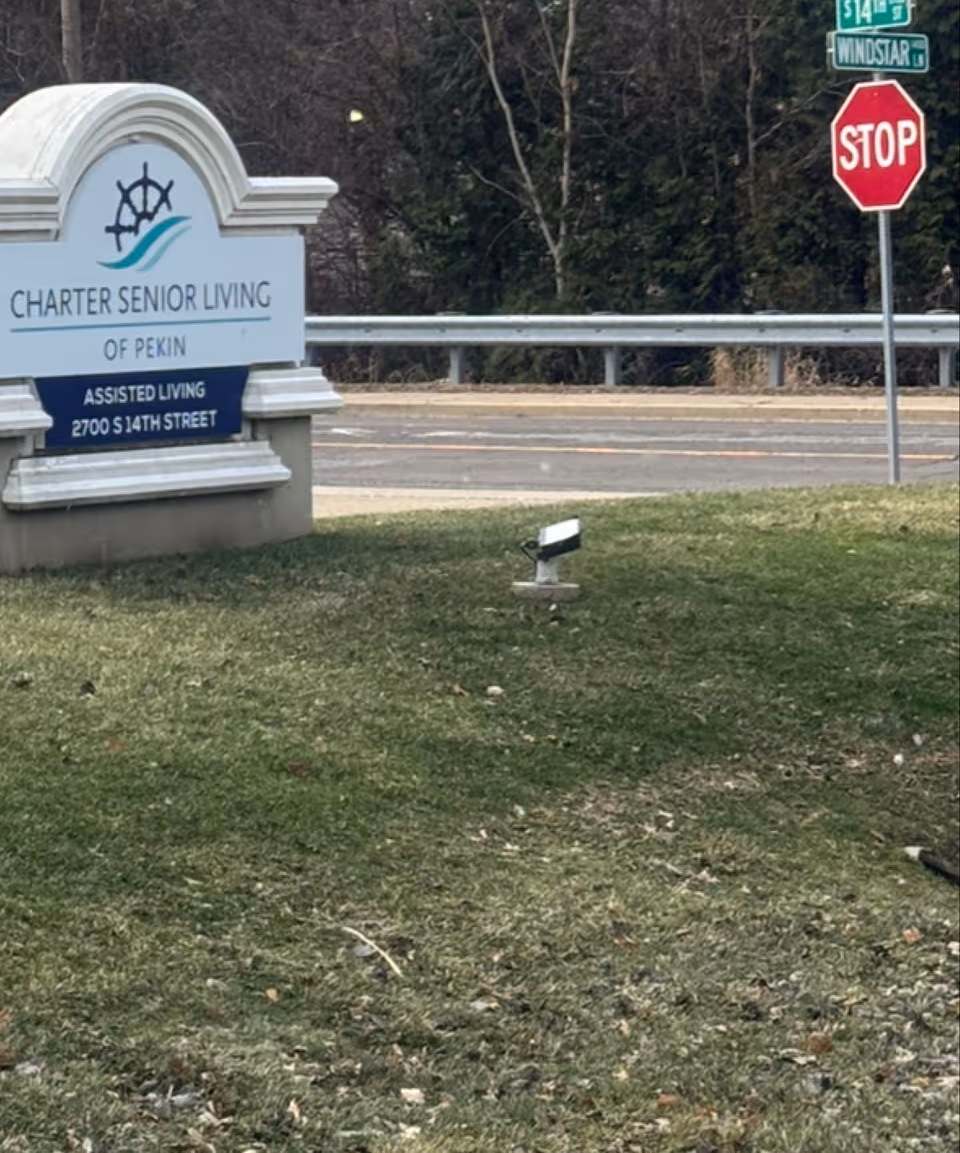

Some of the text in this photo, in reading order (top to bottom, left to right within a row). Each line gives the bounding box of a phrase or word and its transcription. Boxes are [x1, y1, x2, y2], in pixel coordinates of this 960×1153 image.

[843, 0, 852, 19] S
[837, 37, 910, 66] WINDSTAR
[839, 119, 918, 171] STOP
[10, 281, 271, 319] CHARTER SENIOR LIVING
[104, 335, 186, 360] OF PEKIN
[83, 381, 205, 406] ASSISTED LIVING
[72, 410, 218, 438] 2700 S 14TH STREET
